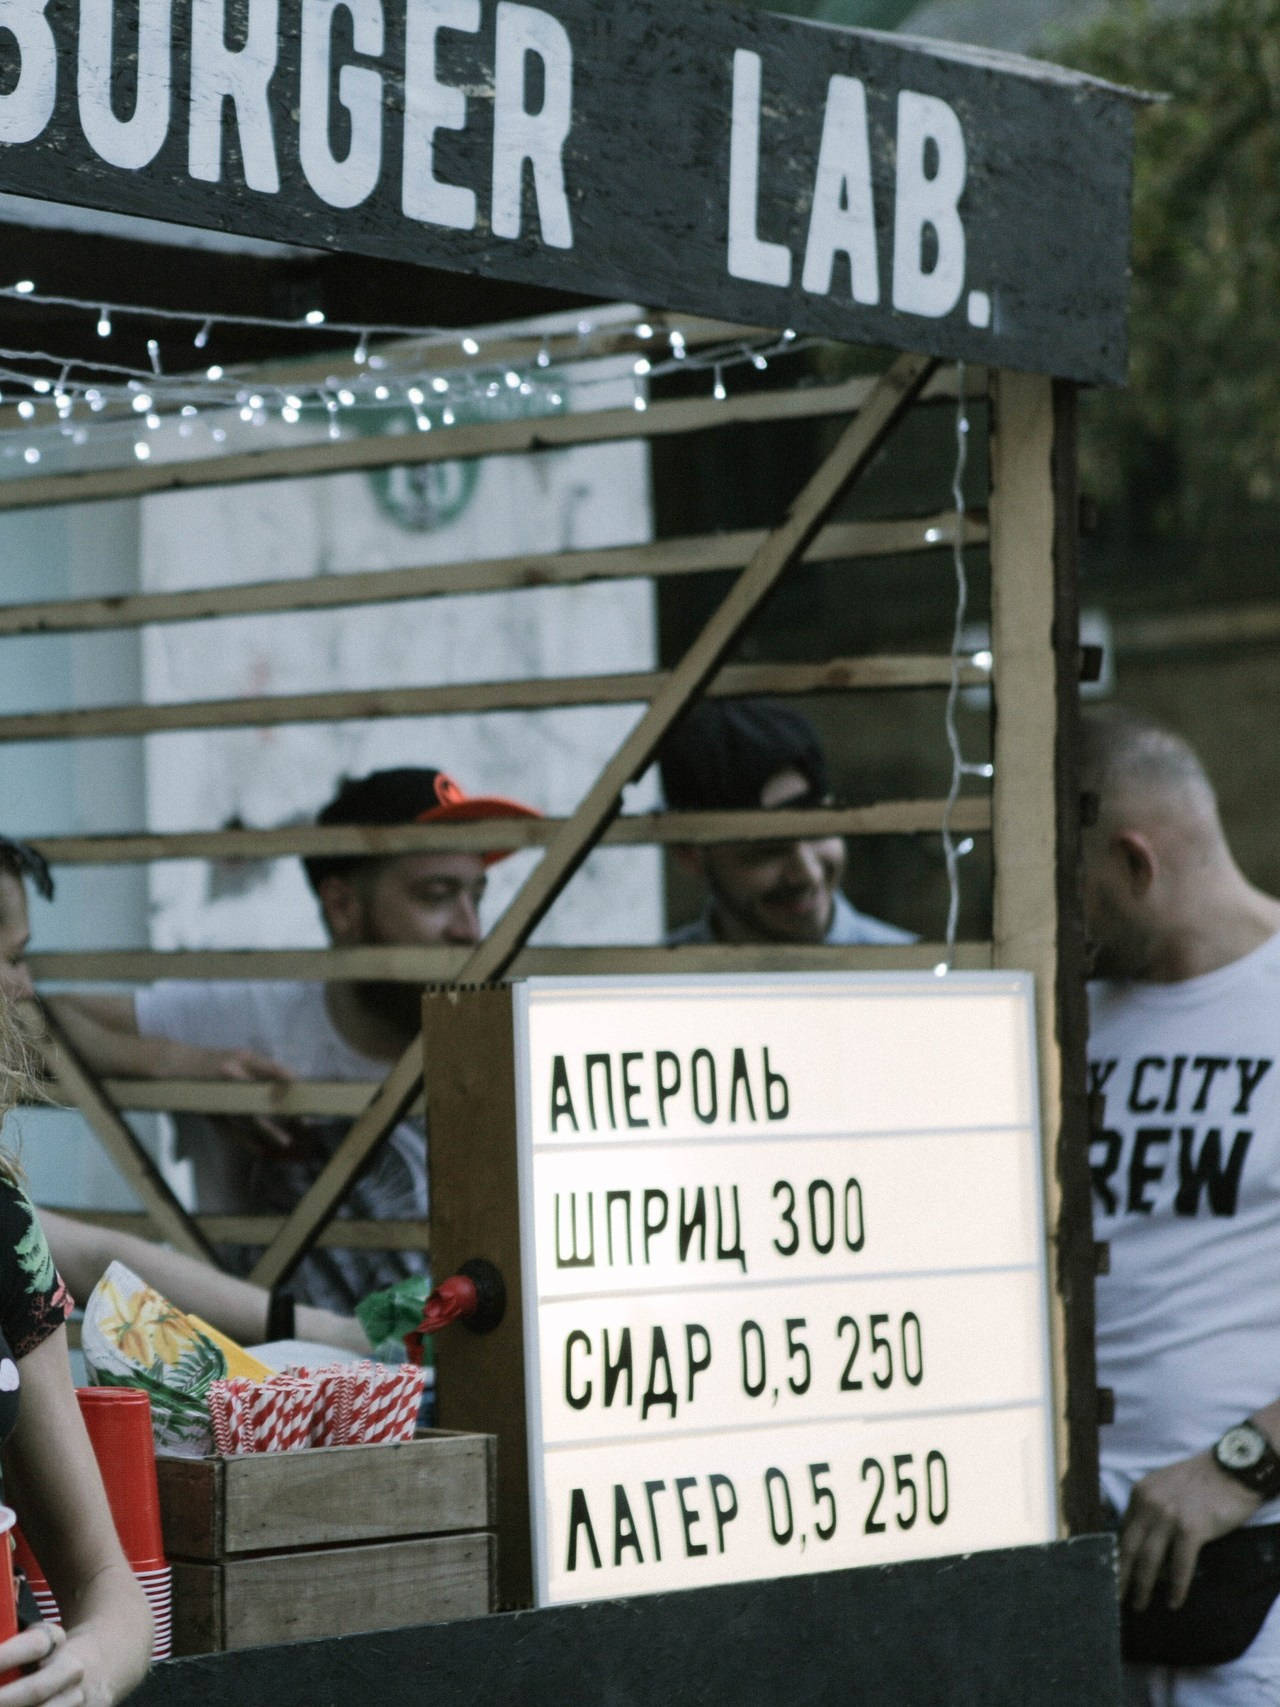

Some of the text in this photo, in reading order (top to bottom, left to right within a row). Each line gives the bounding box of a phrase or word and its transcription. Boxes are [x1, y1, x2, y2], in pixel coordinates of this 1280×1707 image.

[727, 48, 992, 328] LAB.
[551, 1046, 789, 1132] АПЕРОЛЬ
[1126, 1054, 1273, 1115] CITY
[1087, 1125, 1253, 1219] REW
[556, 1177, 865, 1273] ШПРИЦ 300
[565, 1311, 924, 1420] СИДР 0,5 250
[566, 1450, 950, 1572] ЛАГЕР 0,5 250
